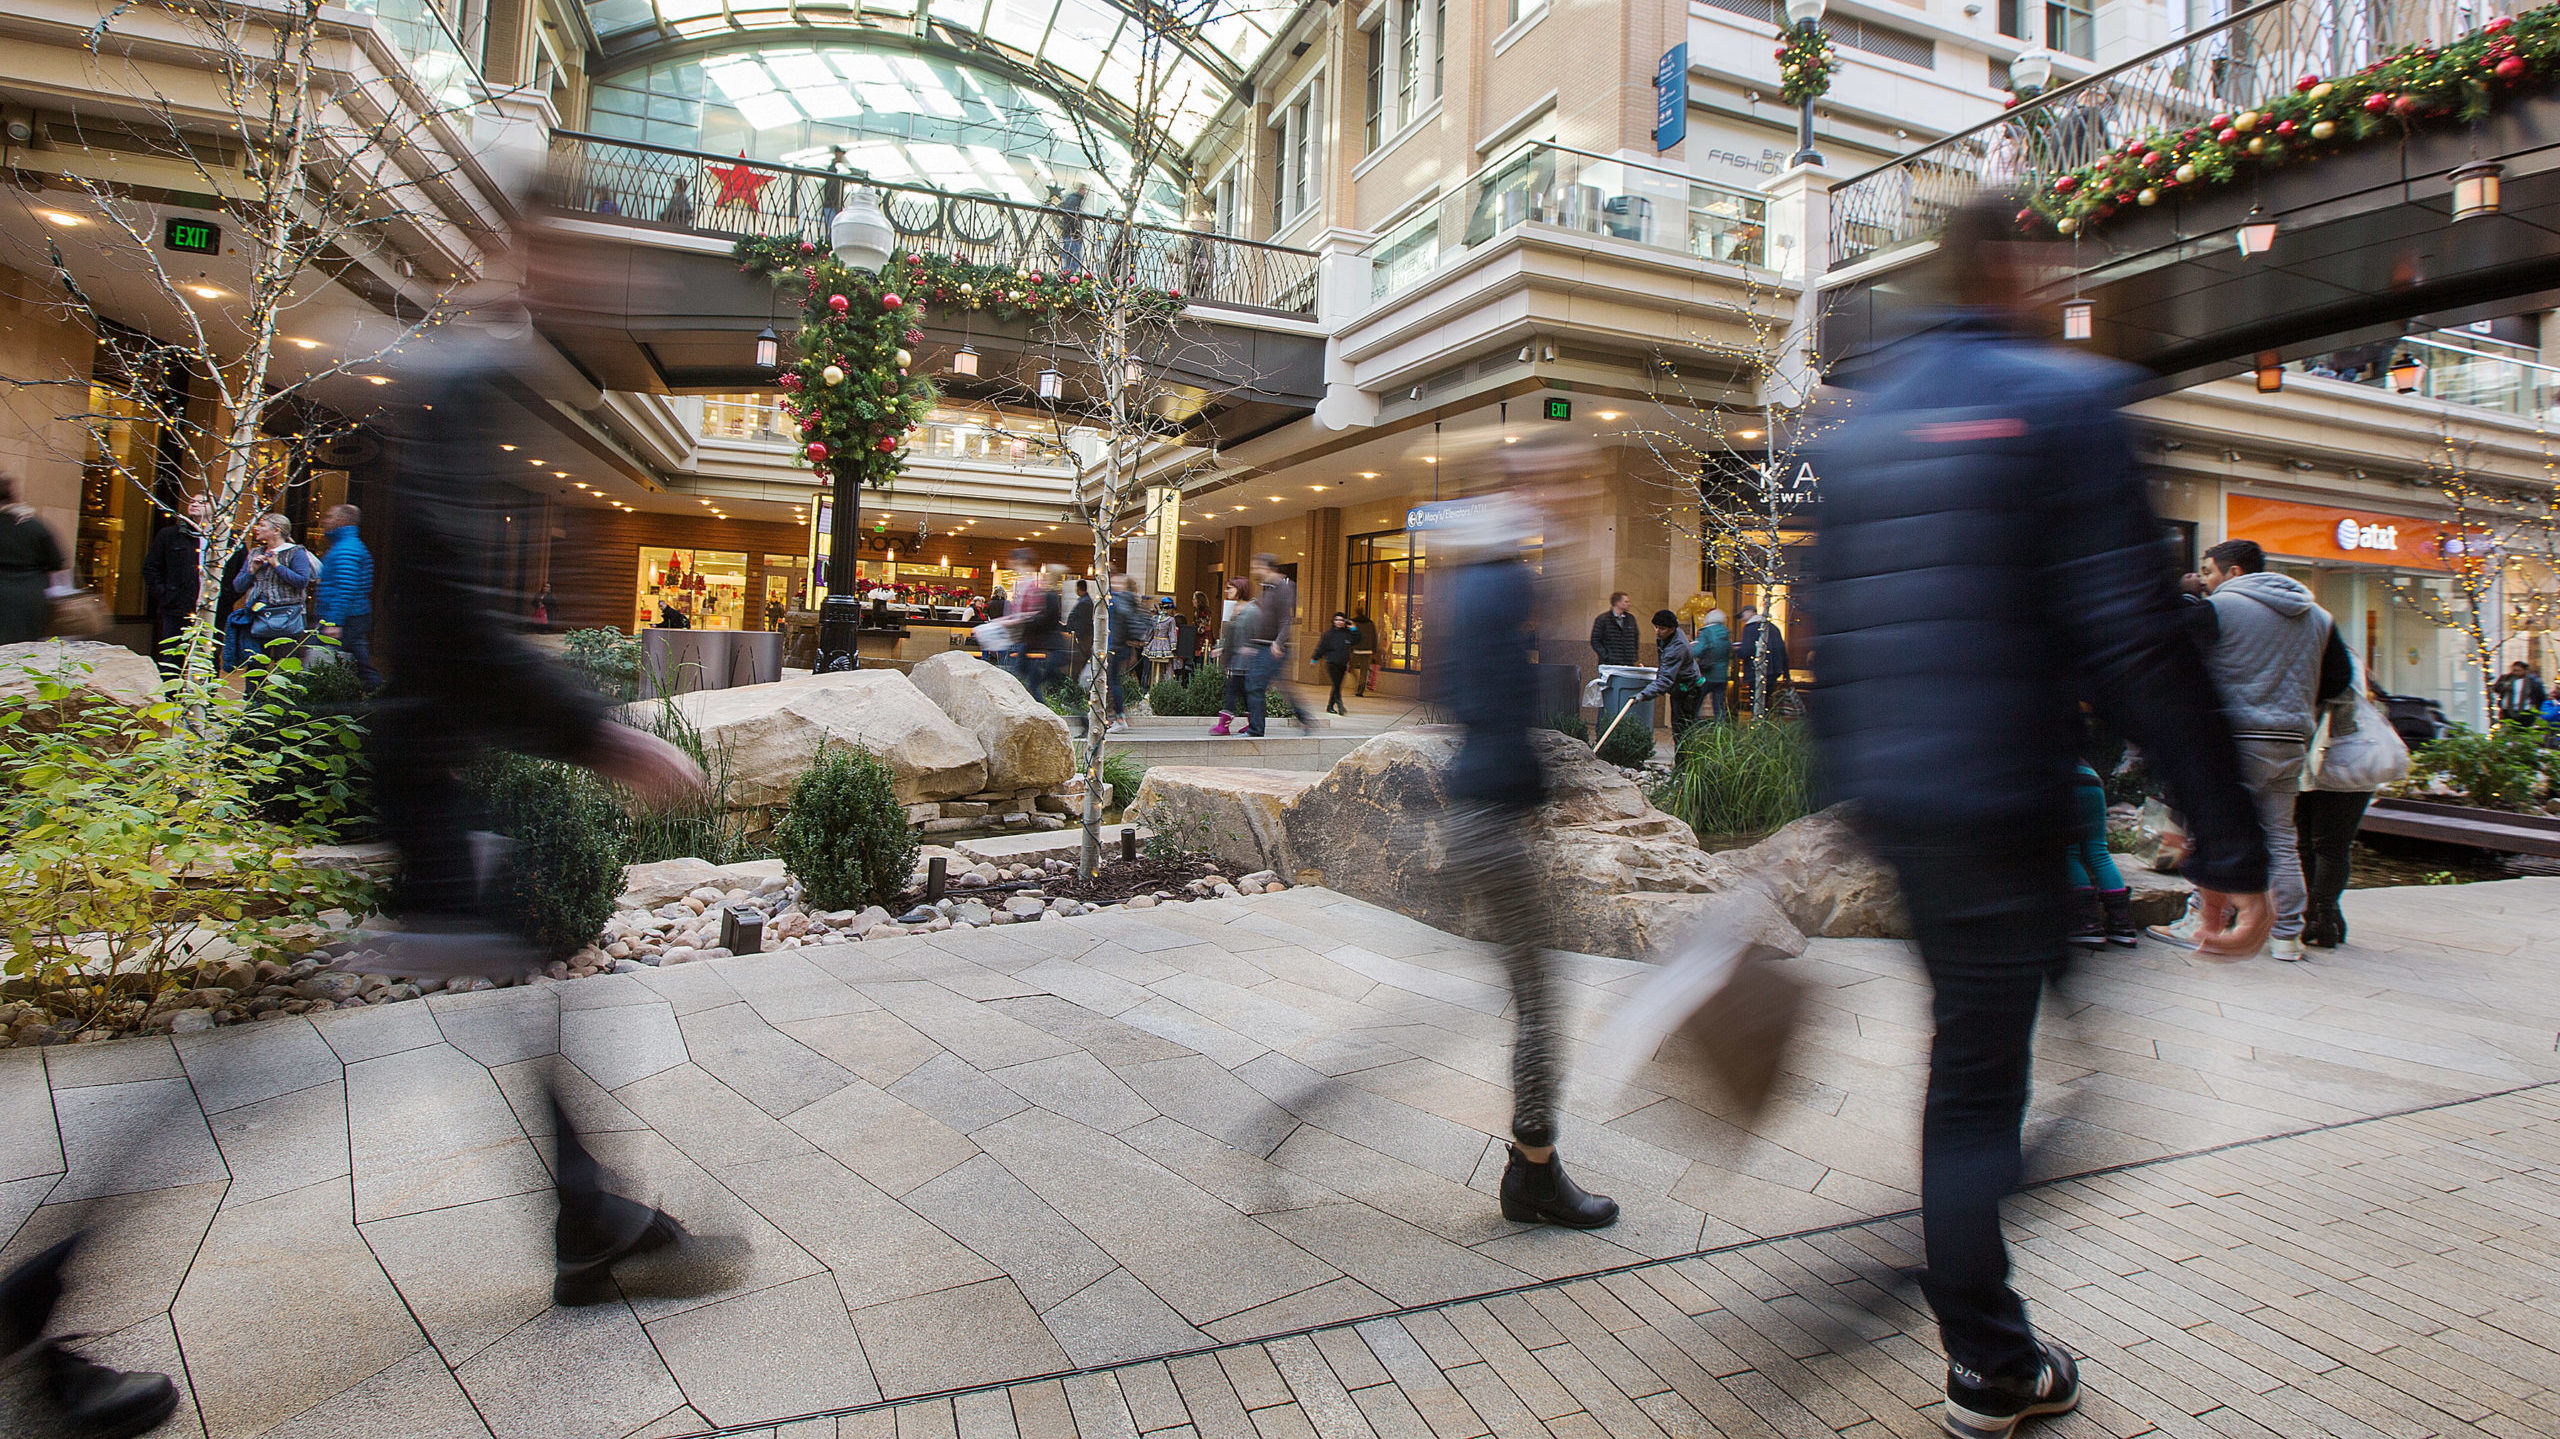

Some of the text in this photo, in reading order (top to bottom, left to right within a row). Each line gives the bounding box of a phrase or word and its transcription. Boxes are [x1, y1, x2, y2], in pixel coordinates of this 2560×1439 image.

[175, 225, 209, 248] EXIT
[1551, 402, 1568, 418] EXIT
[1165, 498, 1174, 545] USTOMER
